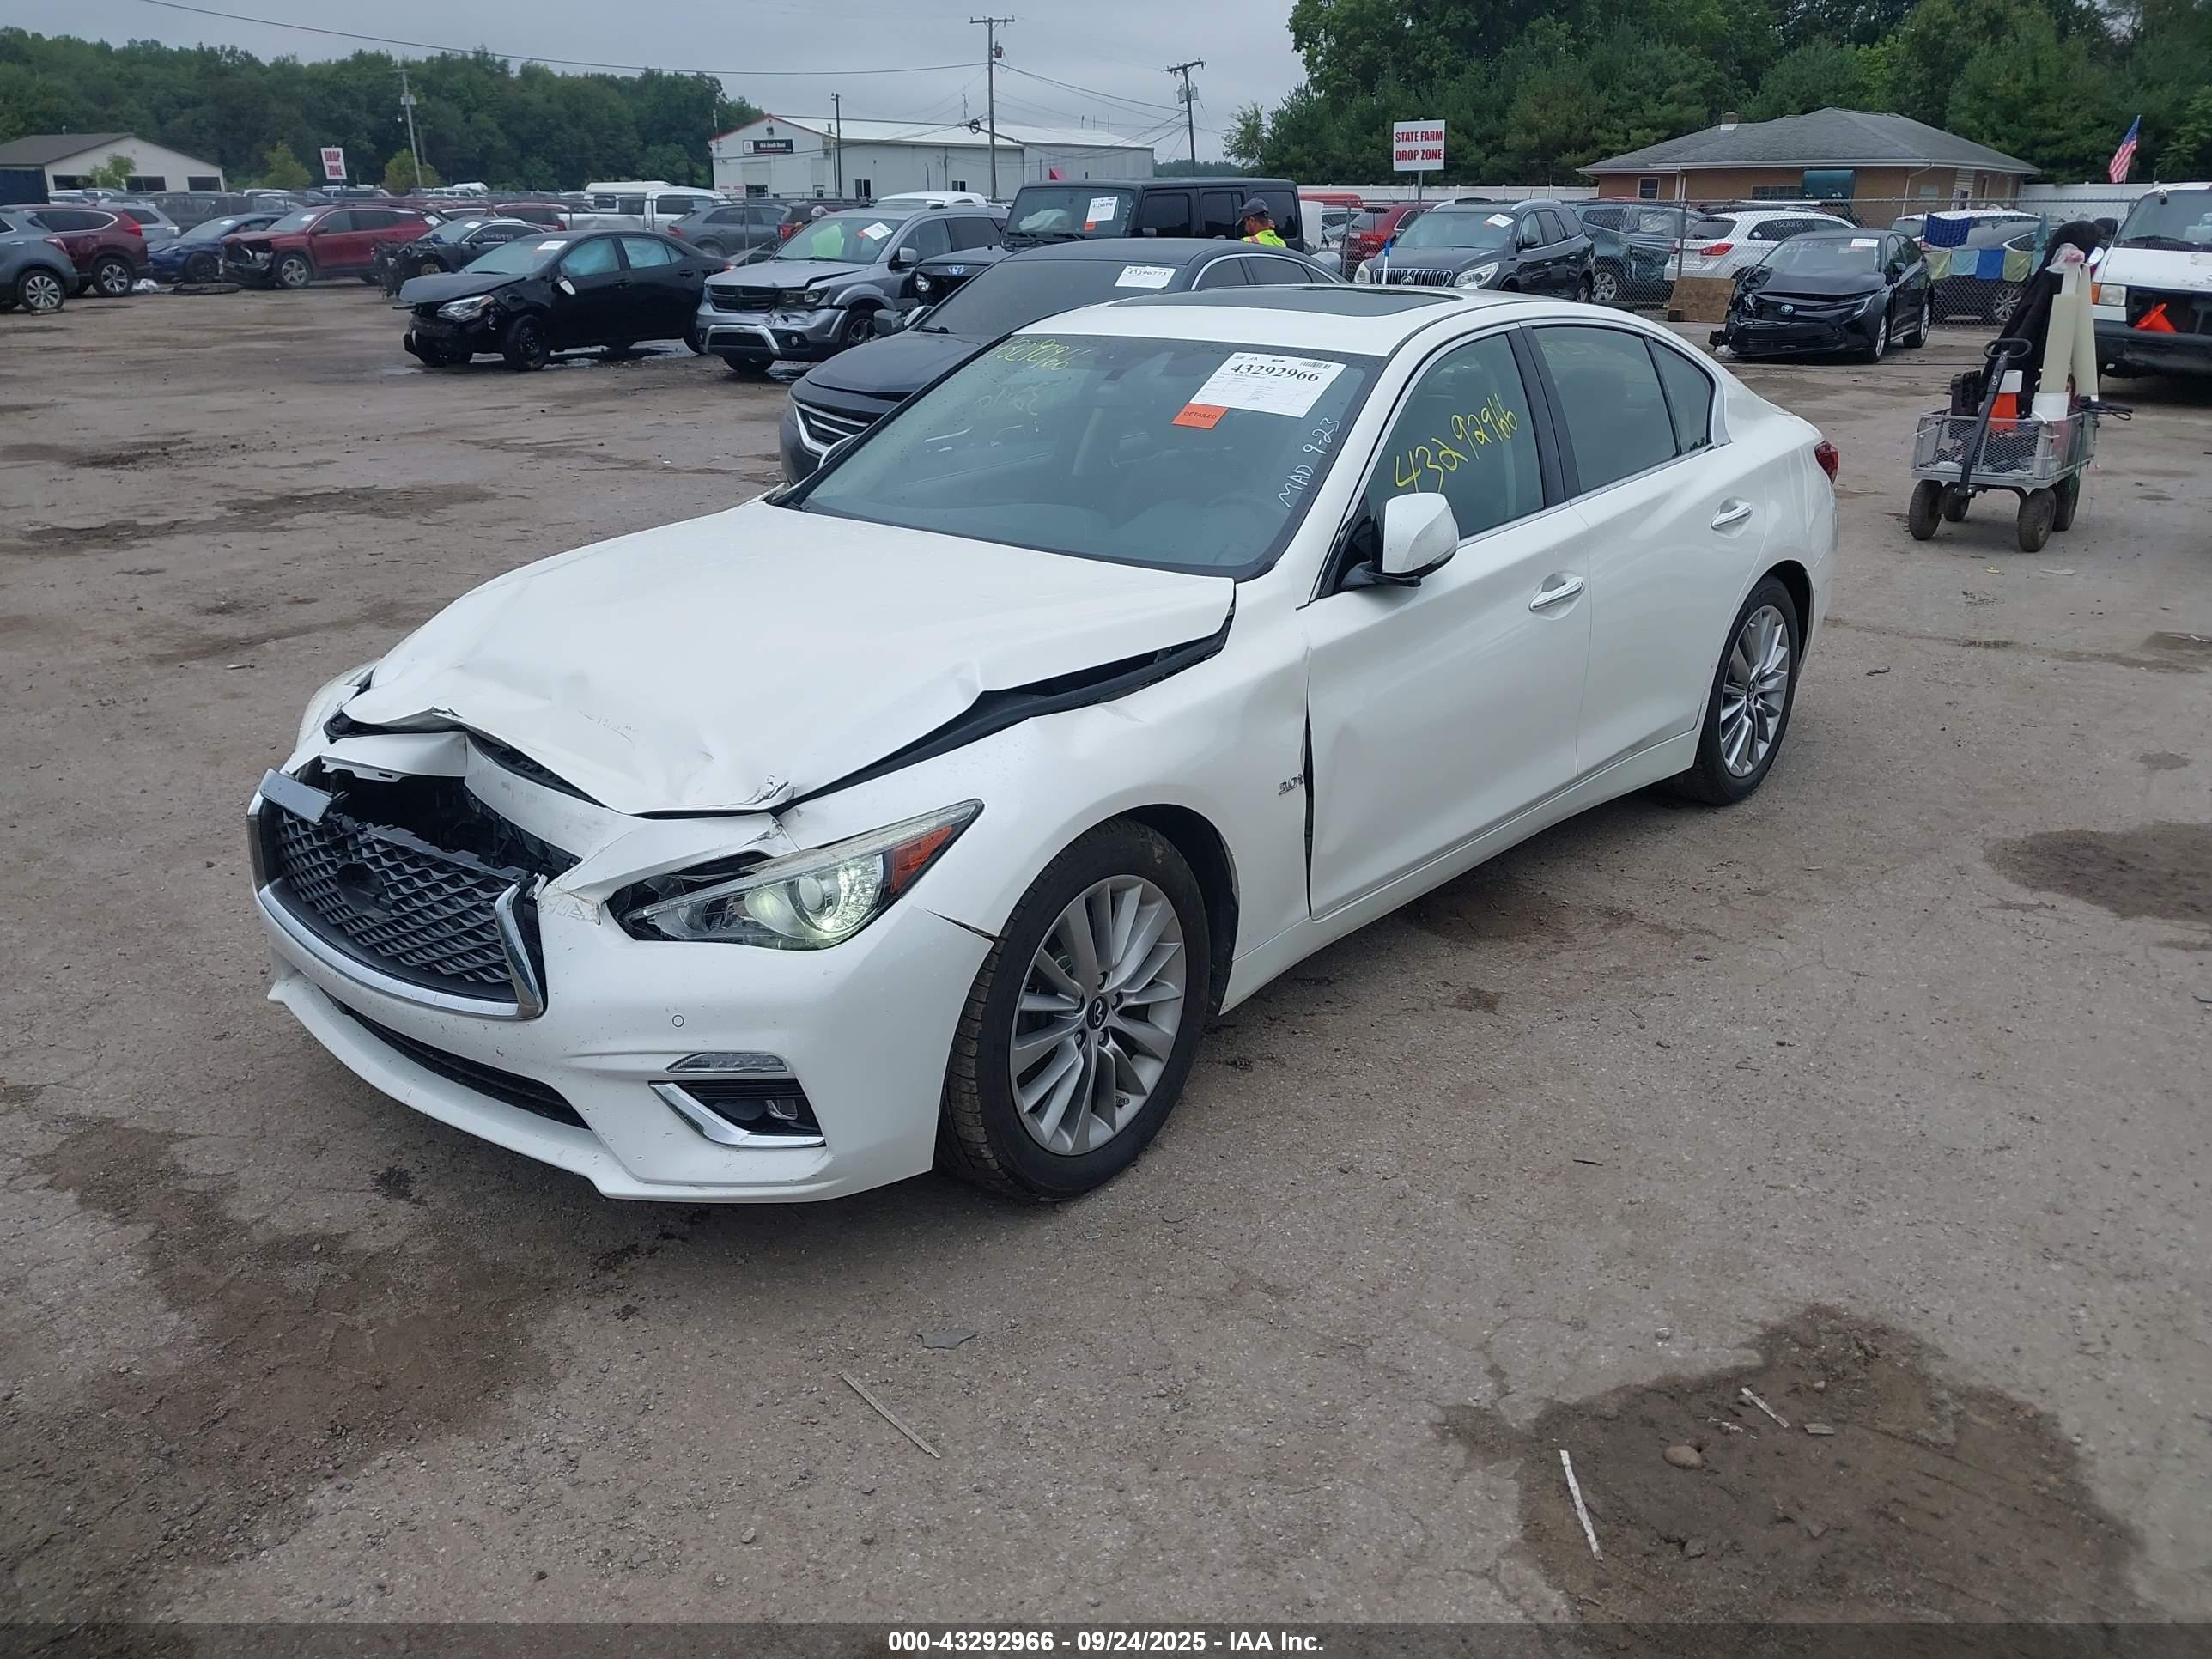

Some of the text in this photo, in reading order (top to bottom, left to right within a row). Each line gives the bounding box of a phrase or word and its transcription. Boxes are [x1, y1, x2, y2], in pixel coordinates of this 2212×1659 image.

[1395, 131, 1443, 143] STATE FARM
[325, 151, 341, 161] DROP
[1395, 149, 1443, 161] DROP ZONE
[328, 165, 343, 175] ZONE
[1231, 363, 1320, 382] 43292966
[1182, 410, 1218, 420] DETAILED
[1395, 393, 1518, 493] 43292966
[1278, 417, 1340, 508] MAD 9-23
